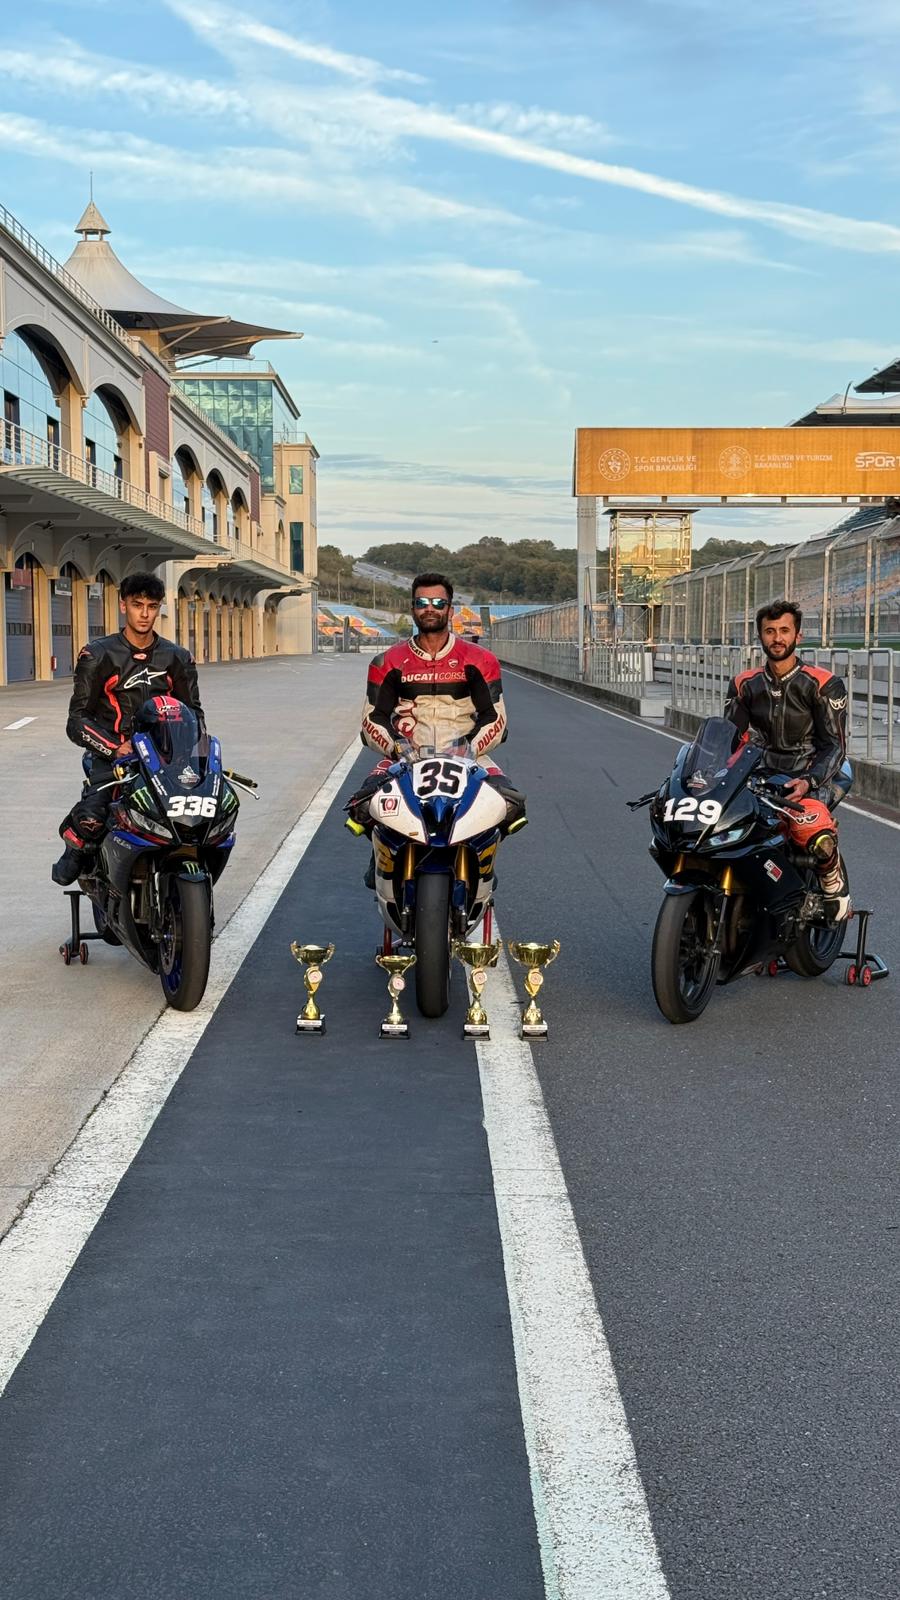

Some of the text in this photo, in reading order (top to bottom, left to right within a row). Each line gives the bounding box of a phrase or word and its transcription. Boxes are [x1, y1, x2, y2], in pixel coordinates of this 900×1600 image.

[634, 464, 654, 472] SPOR
[401, 672, 438, 683] DUCATI
[362, 717, 389, 751] DUCATI
[478, 714, 505, 752] DUCATI
[417, 761, 463, 797] 35
[167, 795, 217, 817] 336
[663, 797, 722, 825] 129
